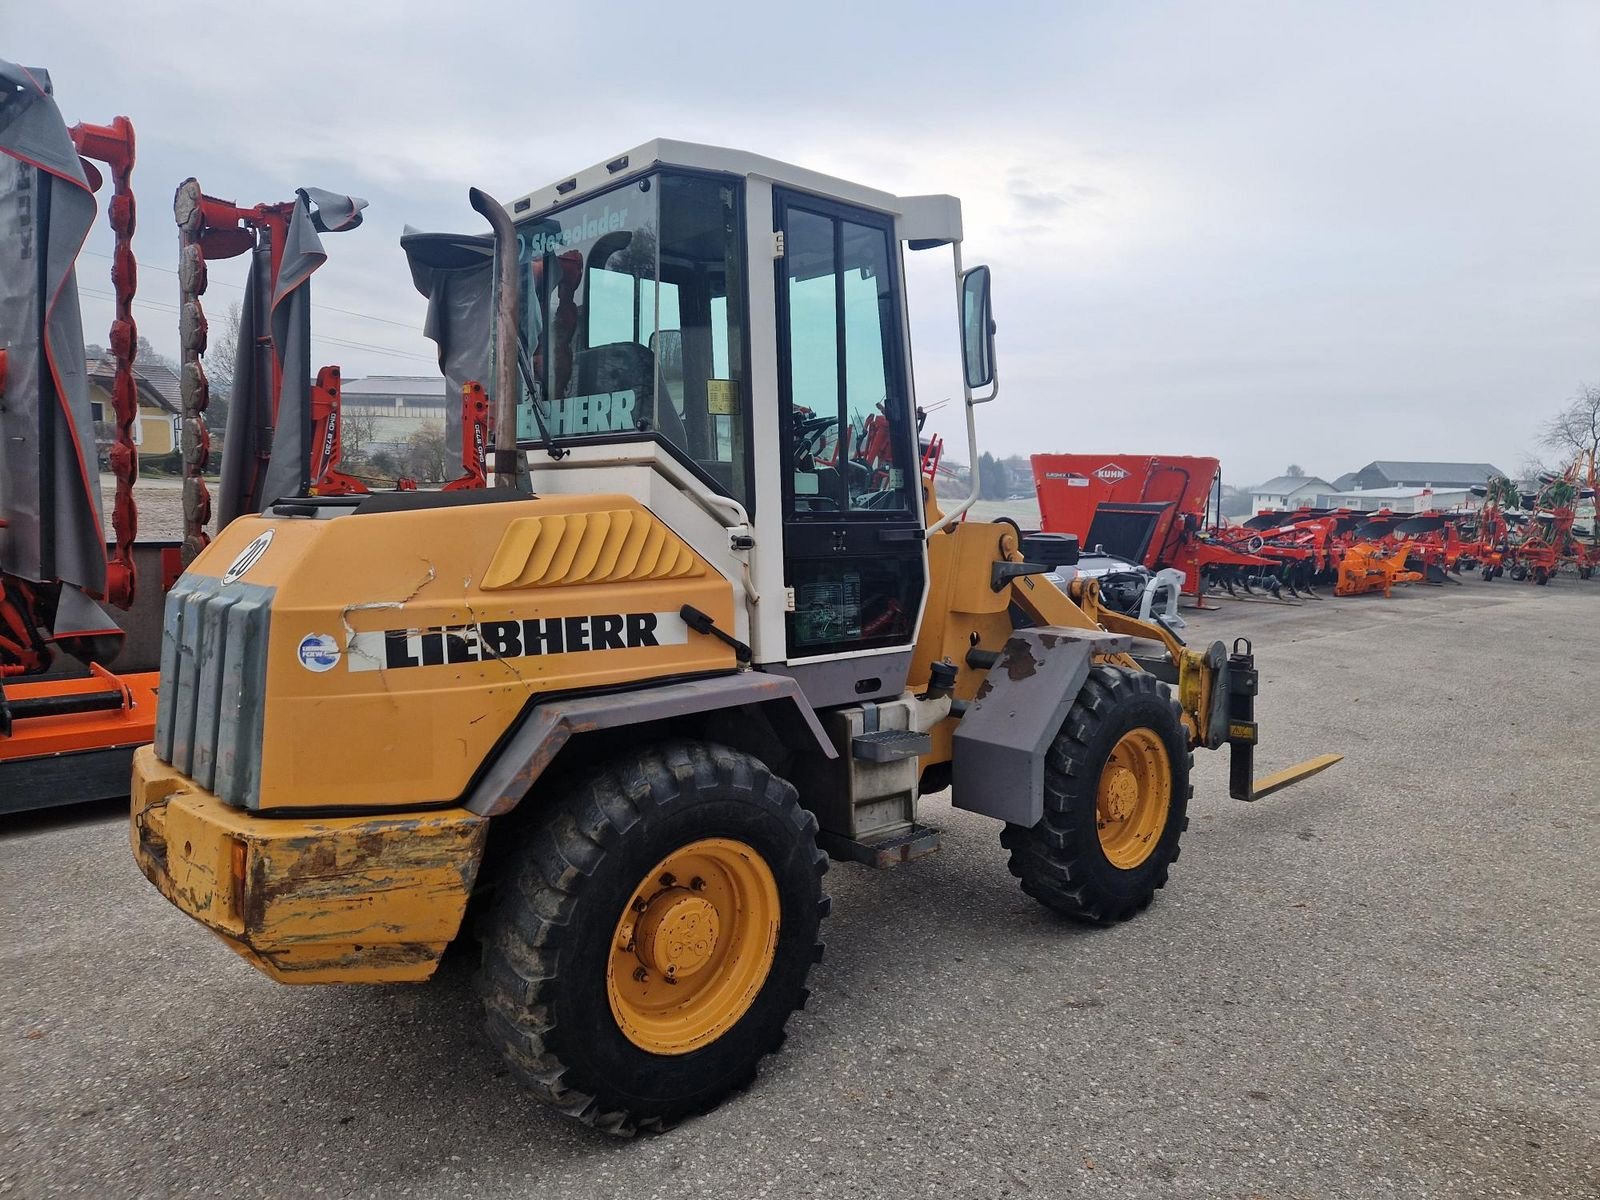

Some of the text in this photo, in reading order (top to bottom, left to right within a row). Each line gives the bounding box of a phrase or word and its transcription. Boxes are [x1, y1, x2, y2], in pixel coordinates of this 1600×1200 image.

[531, 206, 629, 257] Stereolader
[329, 413, 337, 431] GMD
[1097, 470, 1124, 478] KUHN
[228, 539, 268, 577] 20
[384, 612, 660, 669] LIEBHERR
